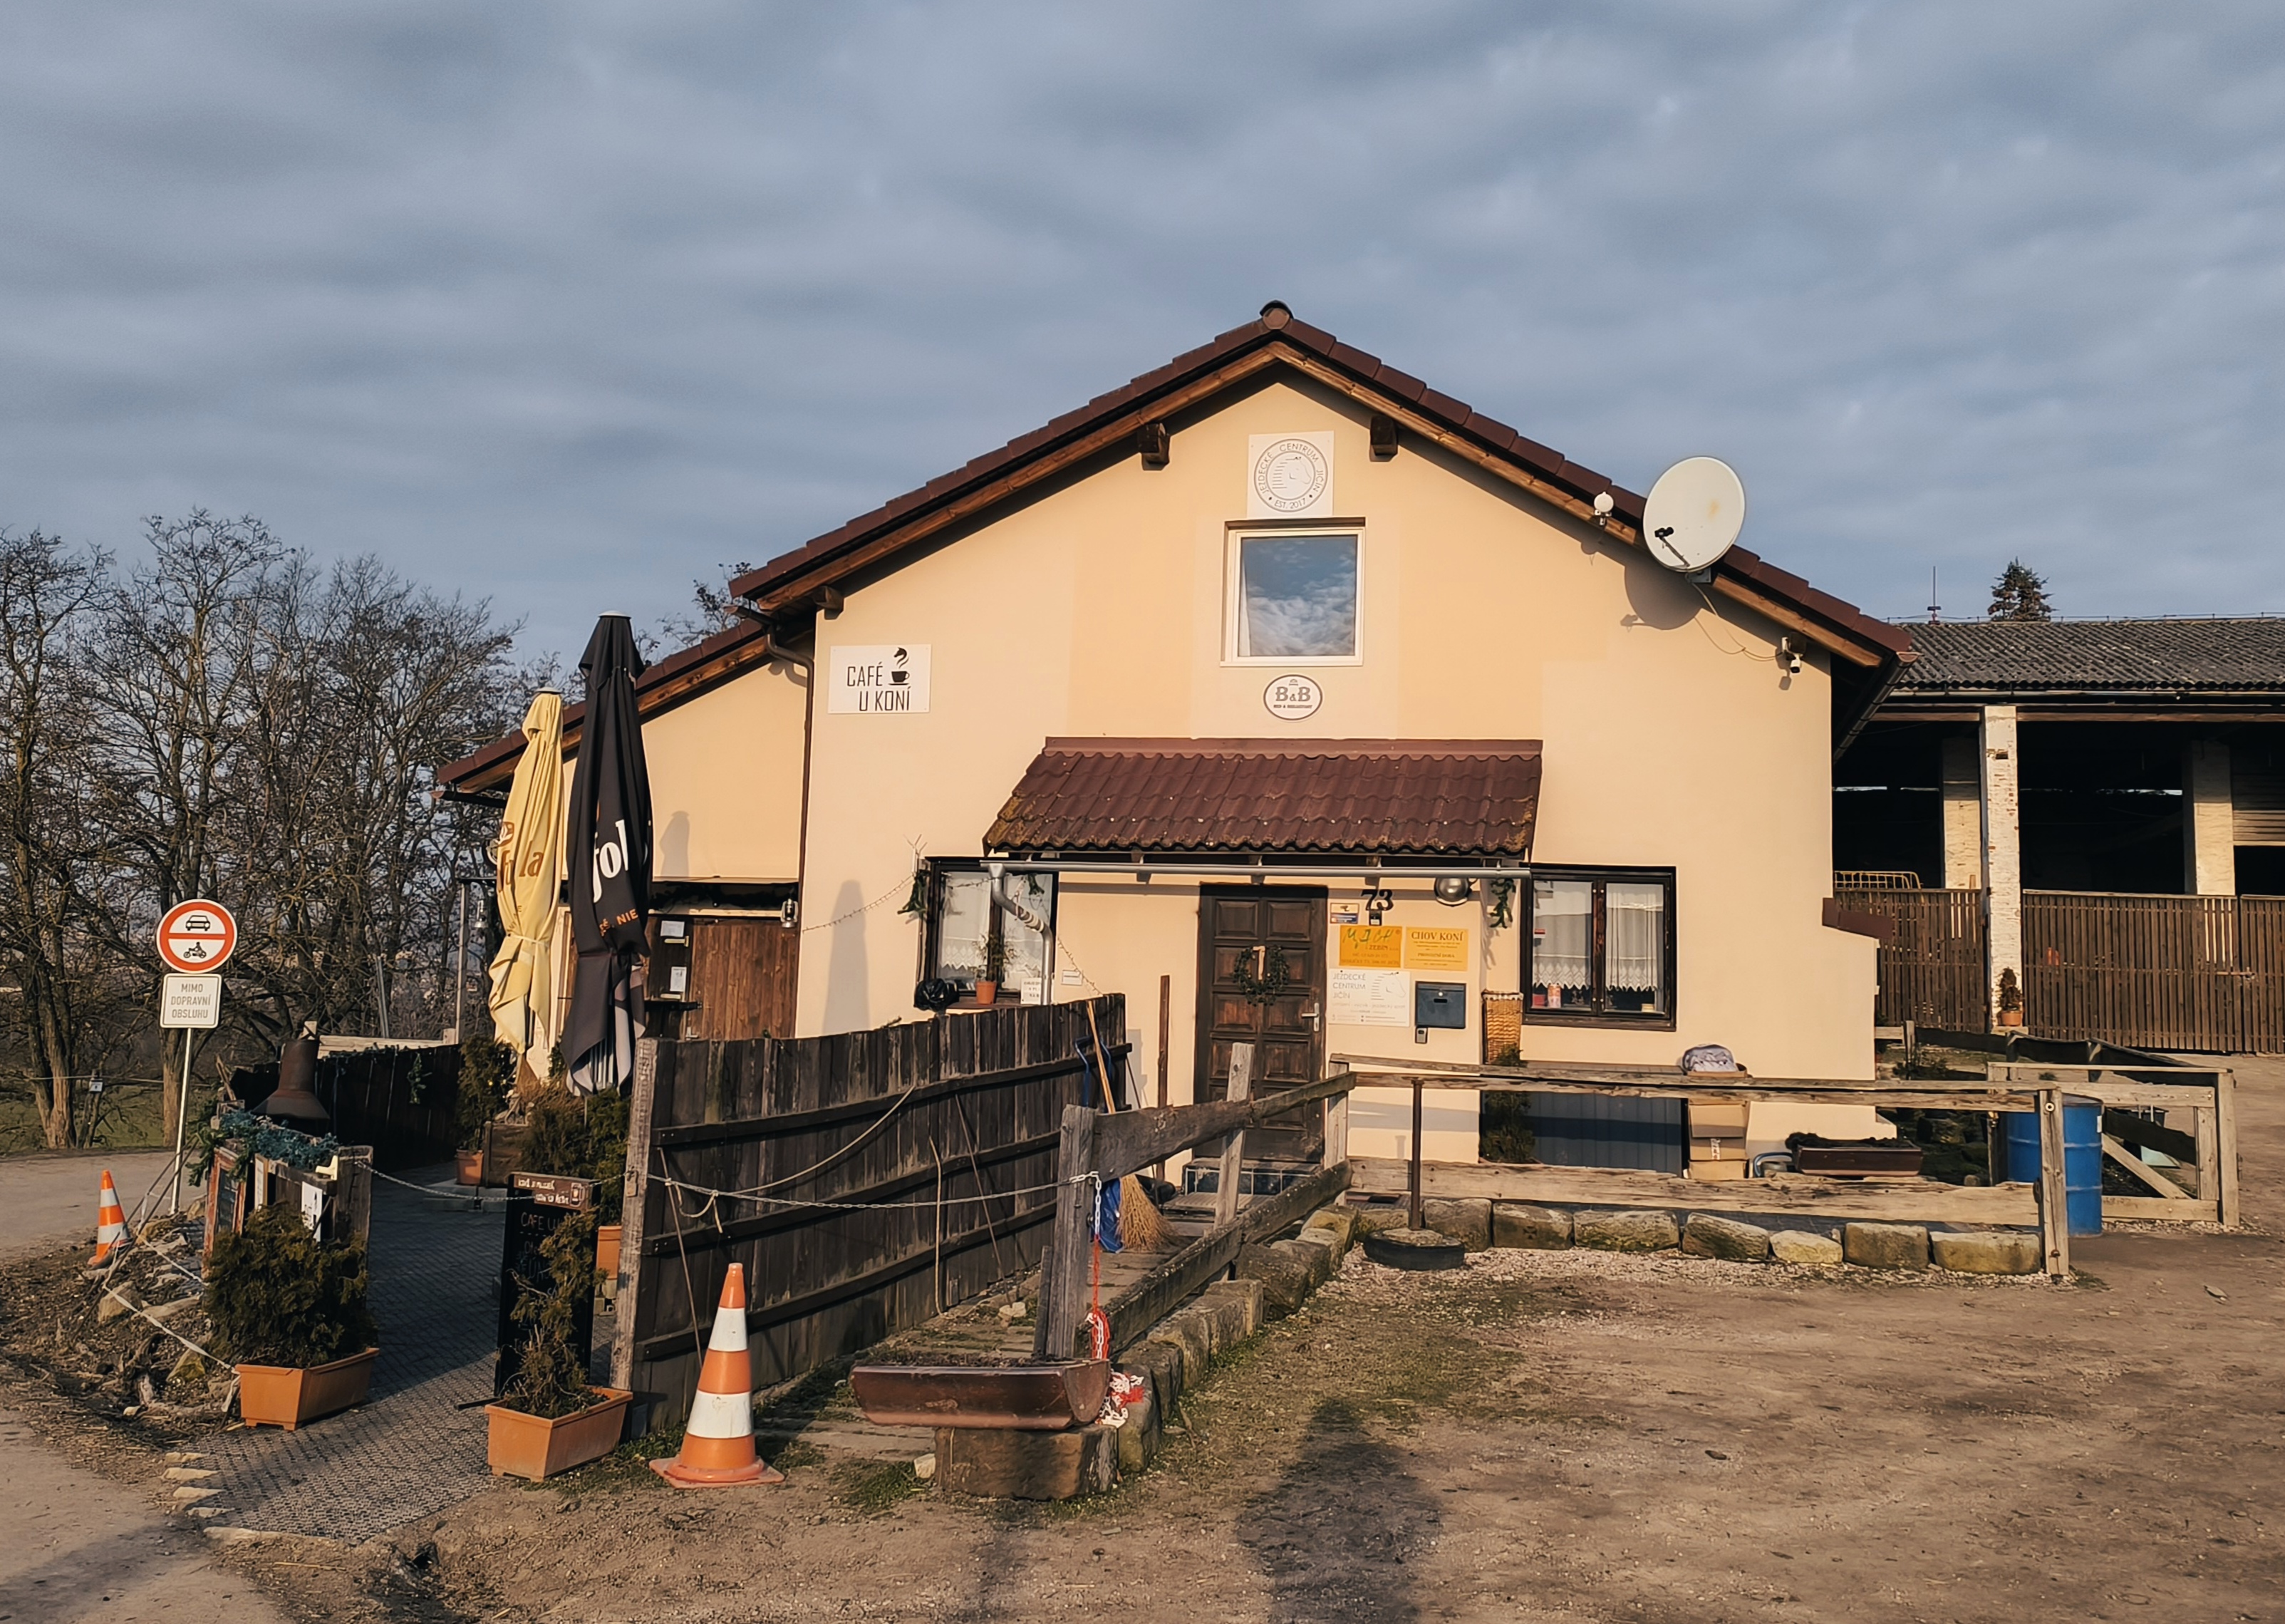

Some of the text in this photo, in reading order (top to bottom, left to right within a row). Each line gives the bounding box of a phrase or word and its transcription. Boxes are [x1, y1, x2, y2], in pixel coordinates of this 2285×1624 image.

[1279, 443, 1319, 462] CENTRUM
[1289, 497, 1305, 509] 2017
[846, 661, 884, 687] CAFÉ
[859, 686, 911, 711] U KONÍ
[1275, 686, 1311, 702] B&B
[1361, 889, 1394, 911] 73
[1411, 931, 1463, 941] CHOV KONÍ
[180, 983, 203, 993] MIMO
[170, 993, 211, 1005] DOPRAVNÍ
[172, 1008, 208, 1019] OBSLUHU
